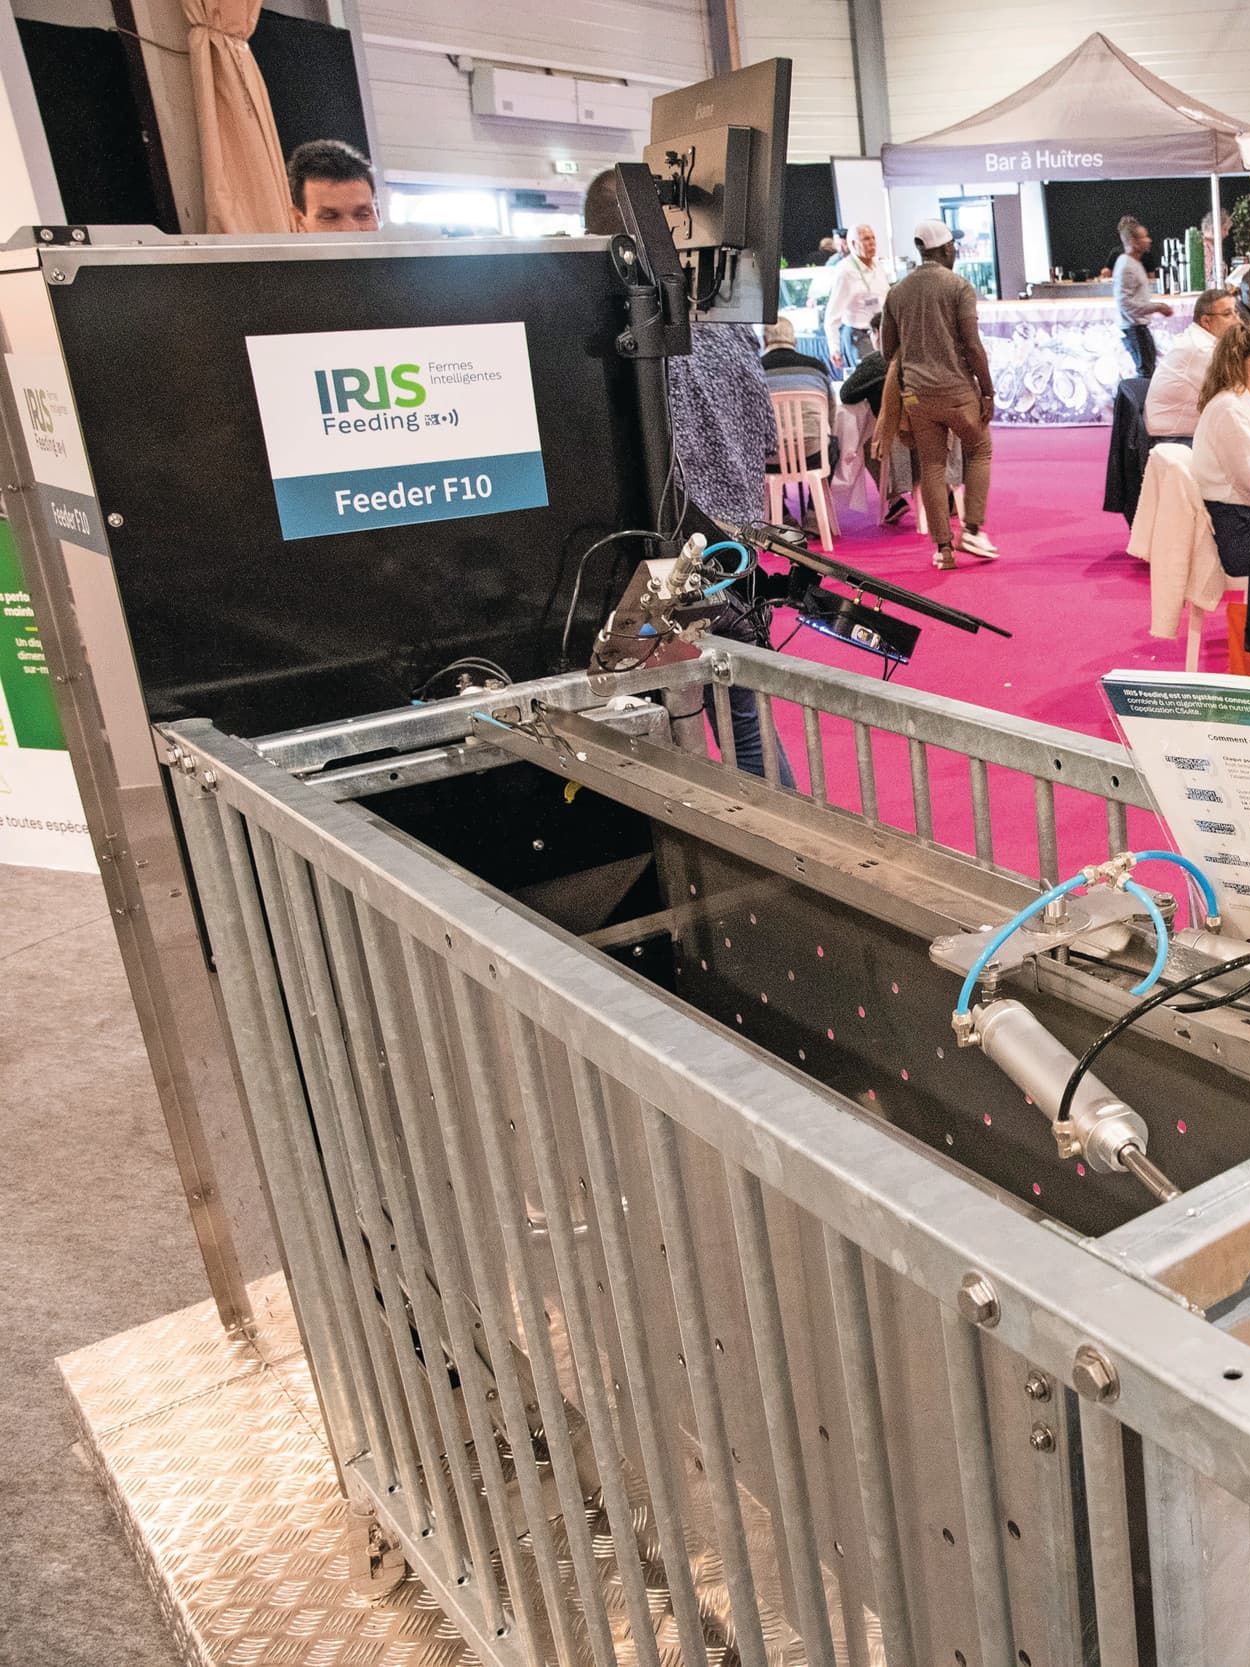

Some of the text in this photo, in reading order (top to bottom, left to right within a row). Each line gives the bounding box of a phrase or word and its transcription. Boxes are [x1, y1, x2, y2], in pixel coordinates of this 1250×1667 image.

[985, 149, 1104, 172] Bar à Huîtres
[314, 360, 473, 415] IRIS Fermes
[430, 370, 502, 385] Intelligentes
[24, 388, 54, 433] IRIS
[323, 412, 420, 435] Feeding
[335, 474, 493, 516] Feeder F10
[51, 501, 91, 536] Feeder F10
[1208, 733, 1248, 743] Comment
[7, 815, 43, 831] toutes
